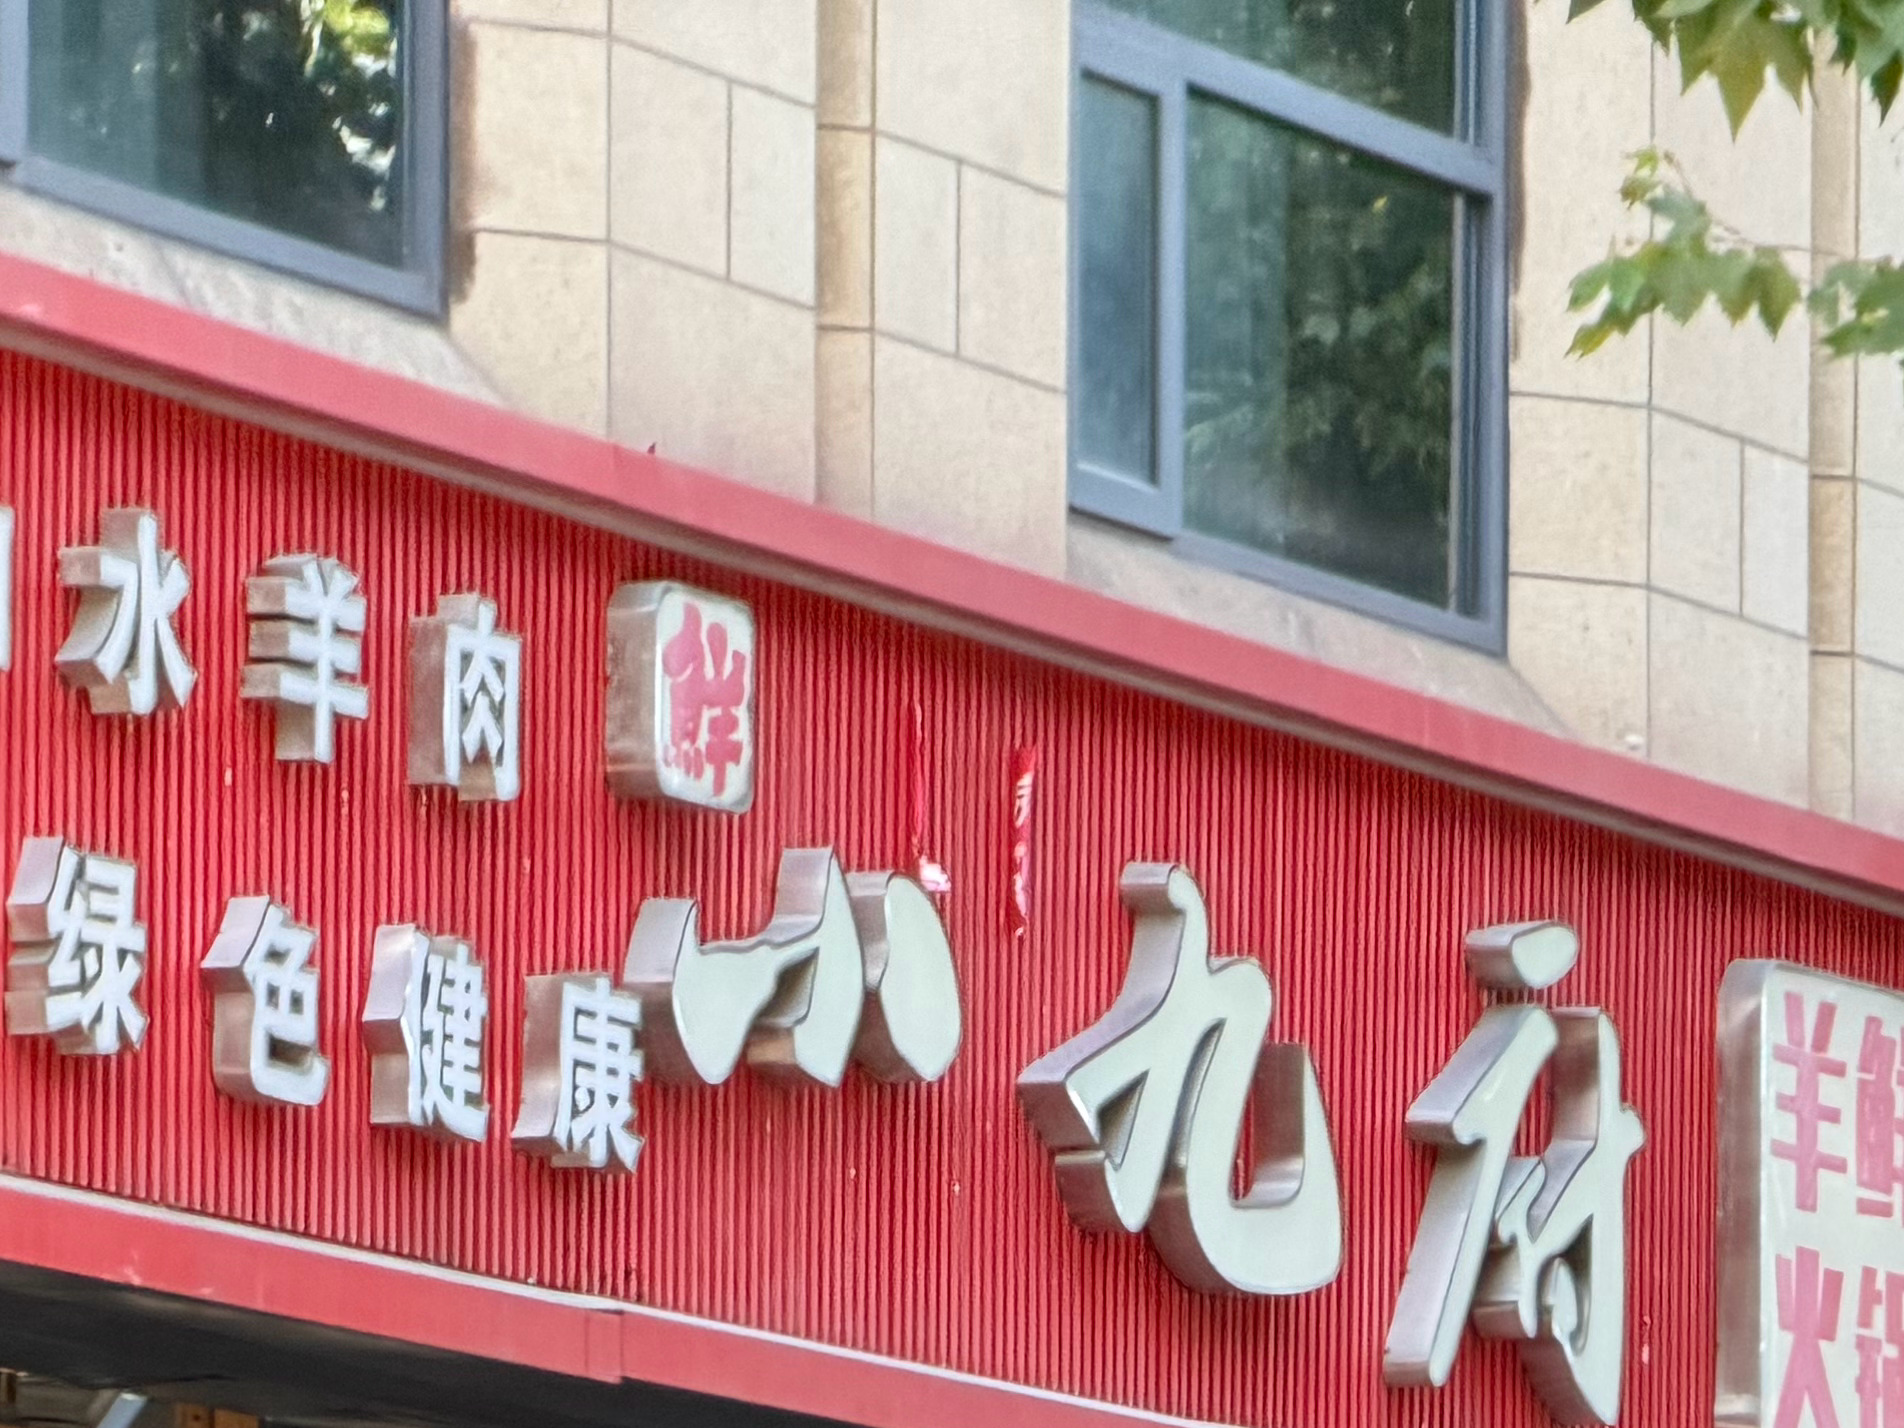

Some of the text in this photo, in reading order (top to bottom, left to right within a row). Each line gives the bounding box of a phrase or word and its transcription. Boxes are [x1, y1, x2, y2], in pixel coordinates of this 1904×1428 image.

[41, 842, 645, 1174] 绿色健康
[646, 848, 1644, 1428] 小九府
